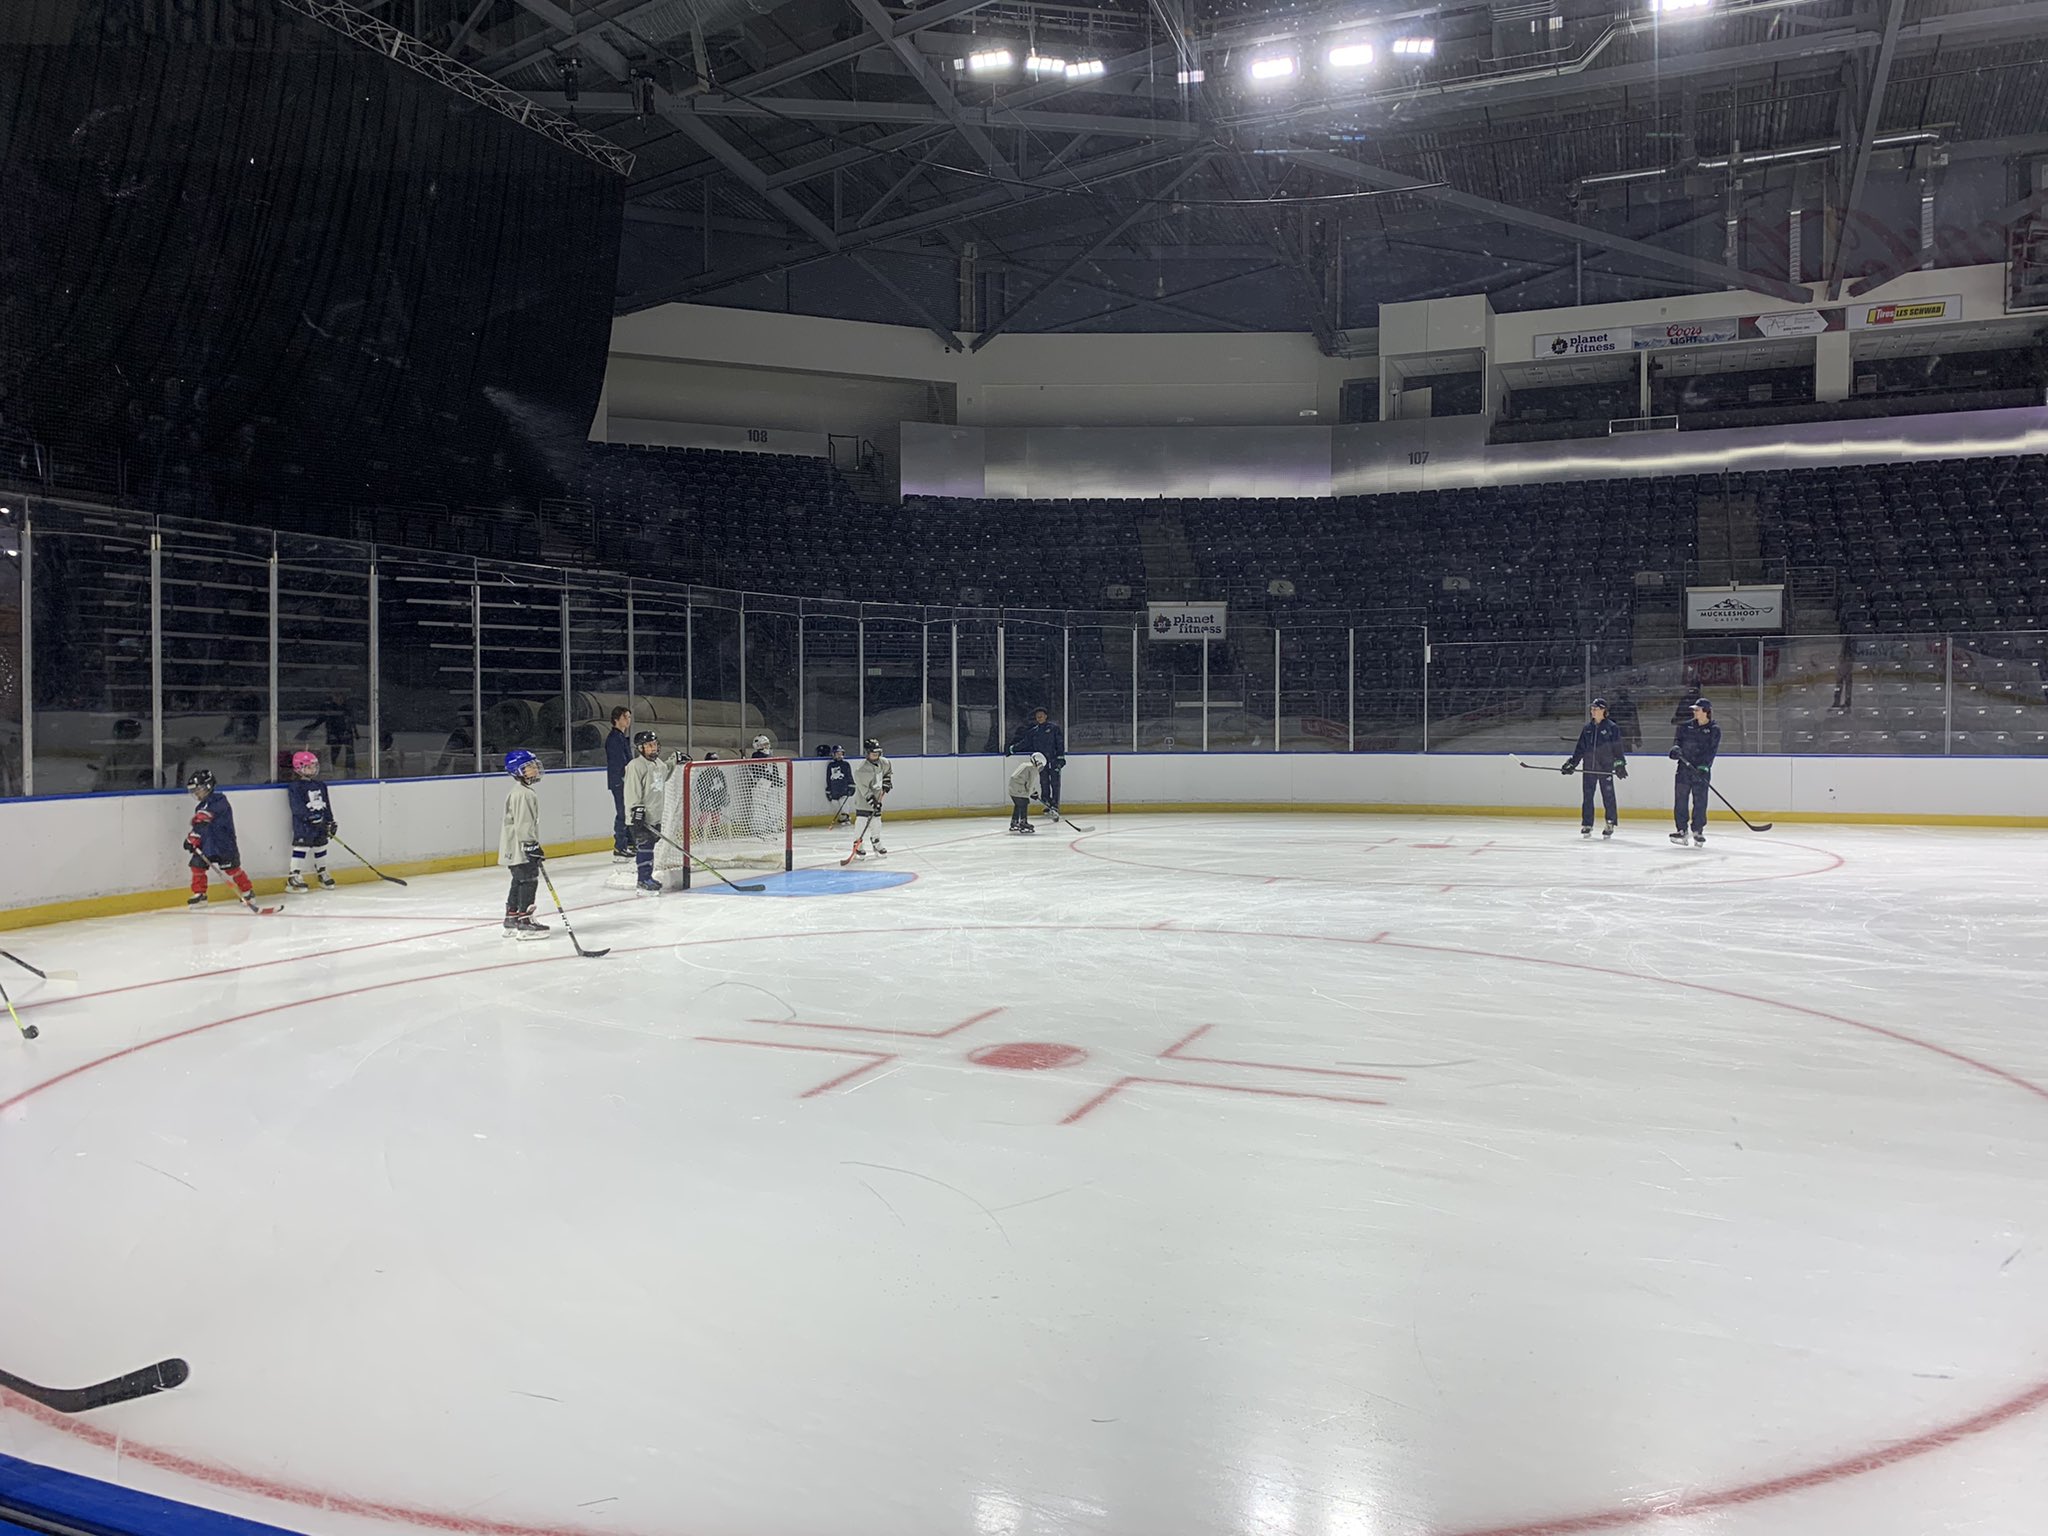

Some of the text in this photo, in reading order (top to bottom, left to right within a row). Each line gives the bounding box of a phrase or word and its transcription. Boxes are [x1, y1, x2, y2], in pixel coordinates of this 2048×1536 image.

[1875, 308, 1894, 320] Tires
[1895, 306, 1941, 317] LES SCHWAB
[1666, 324, 1702, 338] Coors
[1570, 333, 1608, 348] planet
[1670, 336, 1698, 345] LIGHT
[1575, 342, 1616, 354] fitness
[747, 429, 768, 443] 108
[1407, 451, 1430, 465] 107
[1173, 613, 1215, 626] planet
[1179, 623, 1222, 634] fitness
